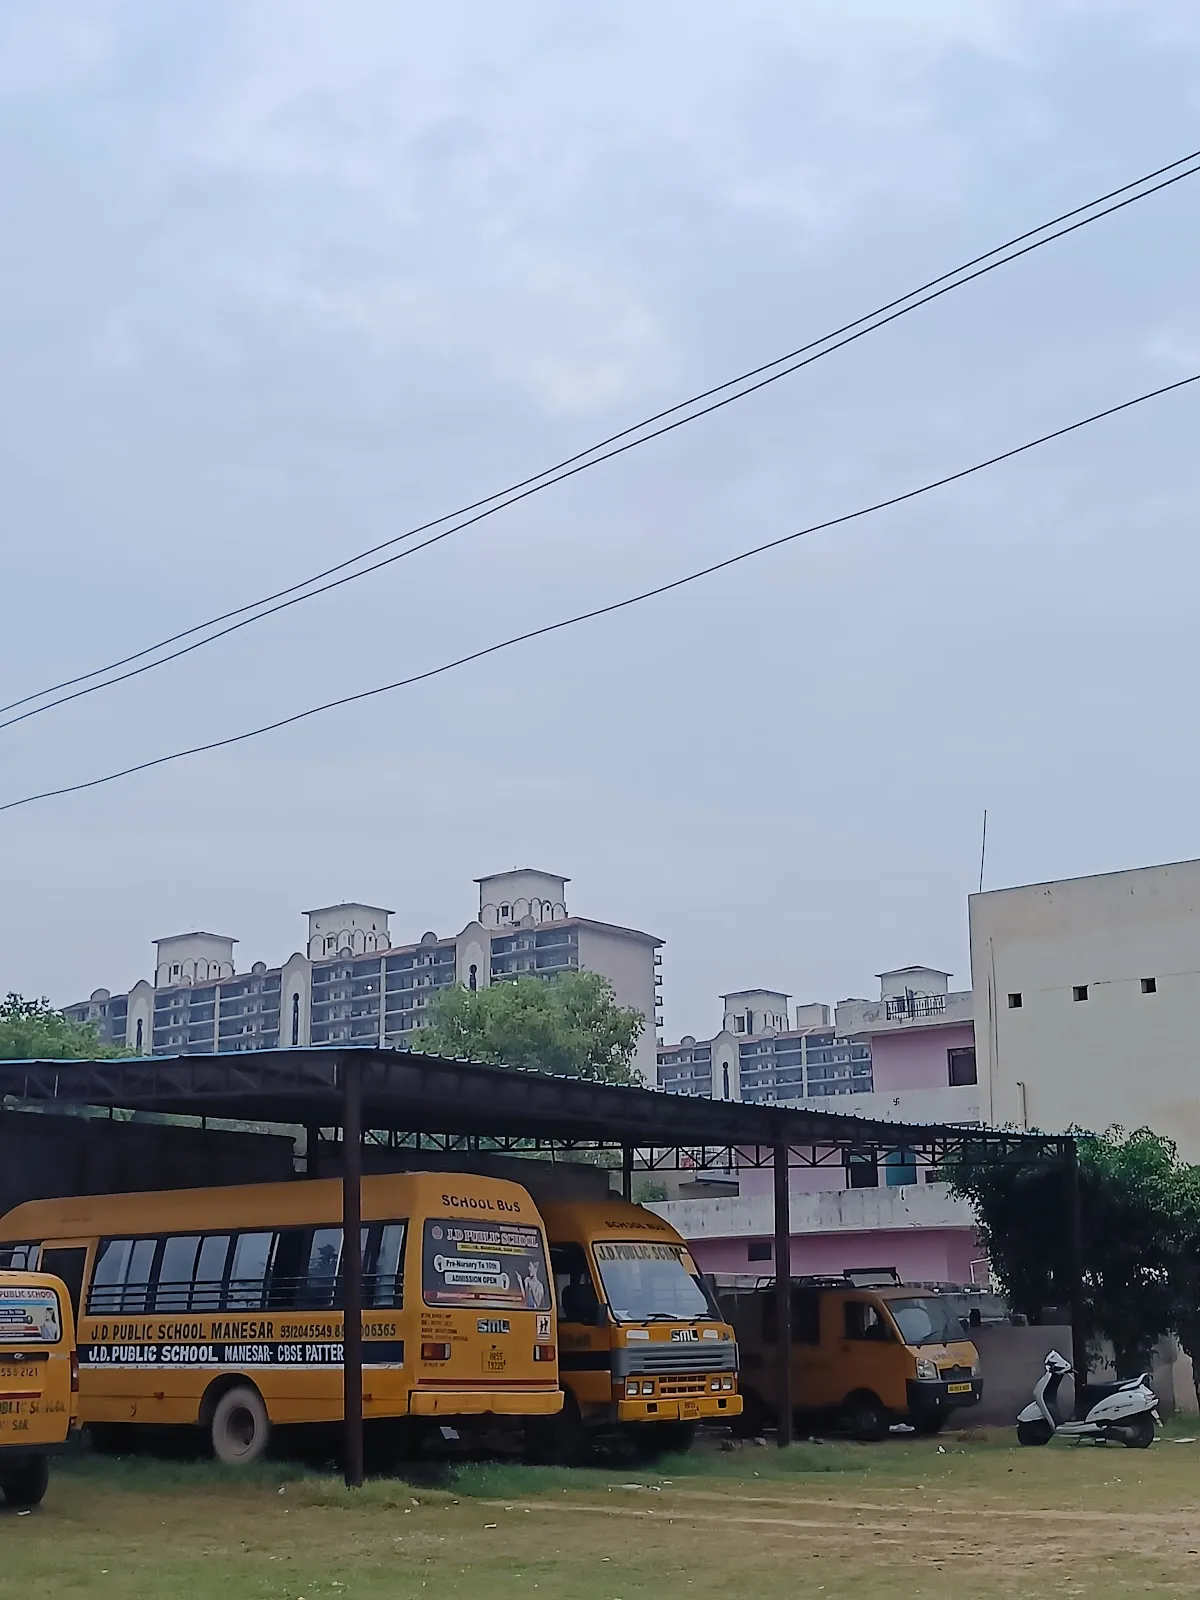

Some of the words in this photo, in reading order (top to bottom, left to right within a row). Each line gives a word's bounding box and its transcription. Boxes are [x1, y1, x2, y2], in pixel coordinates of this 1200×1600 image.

[441, 1194, 495, 1210] SCHOOL
[496, 1200, 521, 1212] BUS
[464, 1229, 501, 1244] PUBLIC
[501, 1233, 539, 1248] SCHOOL
[482, 1276, 498, 1284] OPEN
[112, 1324, 153, 1340] PUBLIC
[158, 1322, 207, 1340] SCHOOL
[211, 1321, 274, 1340] MANESAR
[160, 1345, 219, 1362] SCHOOL
[277, 1344, 303, 1361] CBSE
[20, 1367, 38, 1377] 2121
